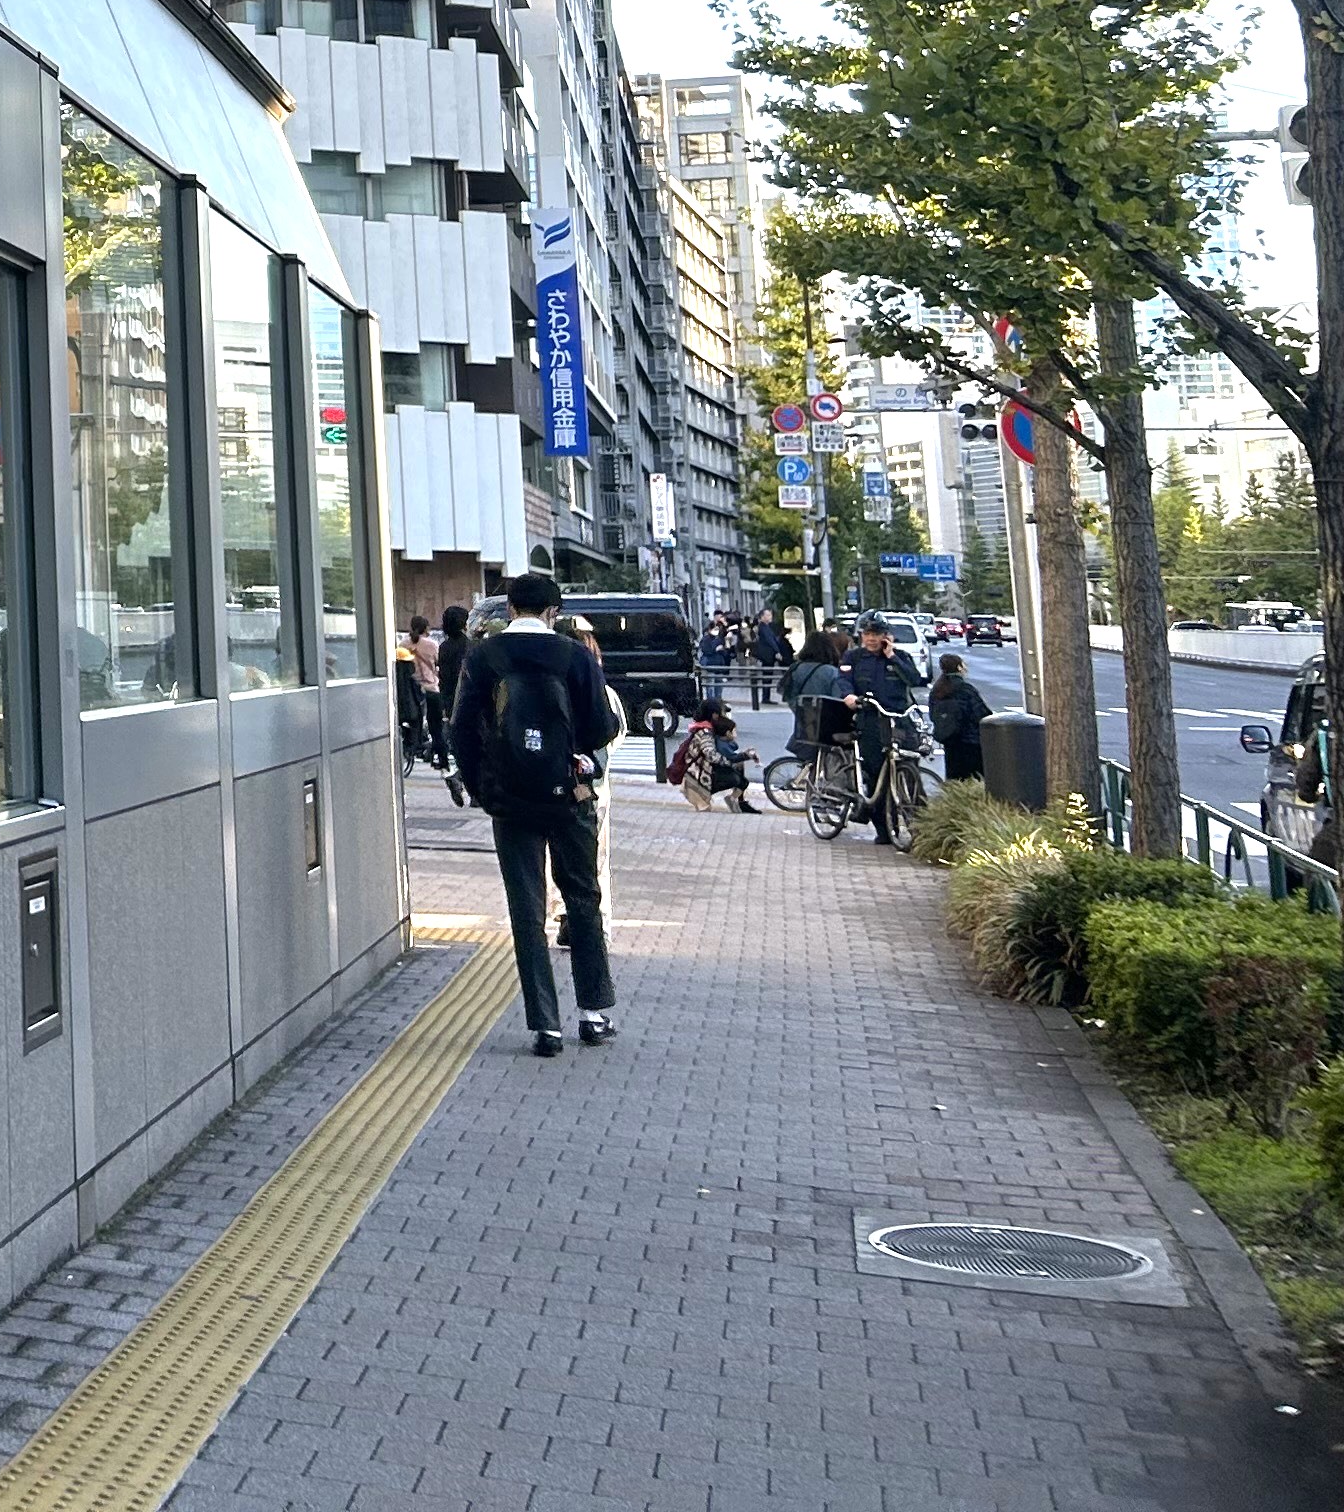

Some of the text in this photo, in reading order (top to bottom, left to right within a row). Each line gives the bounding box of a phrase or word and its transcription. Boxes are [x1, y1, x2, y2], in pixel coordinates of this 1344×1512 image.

[547, 288, 577, 448] さわやか信用金庫
[784, 462, 797, 481] P
